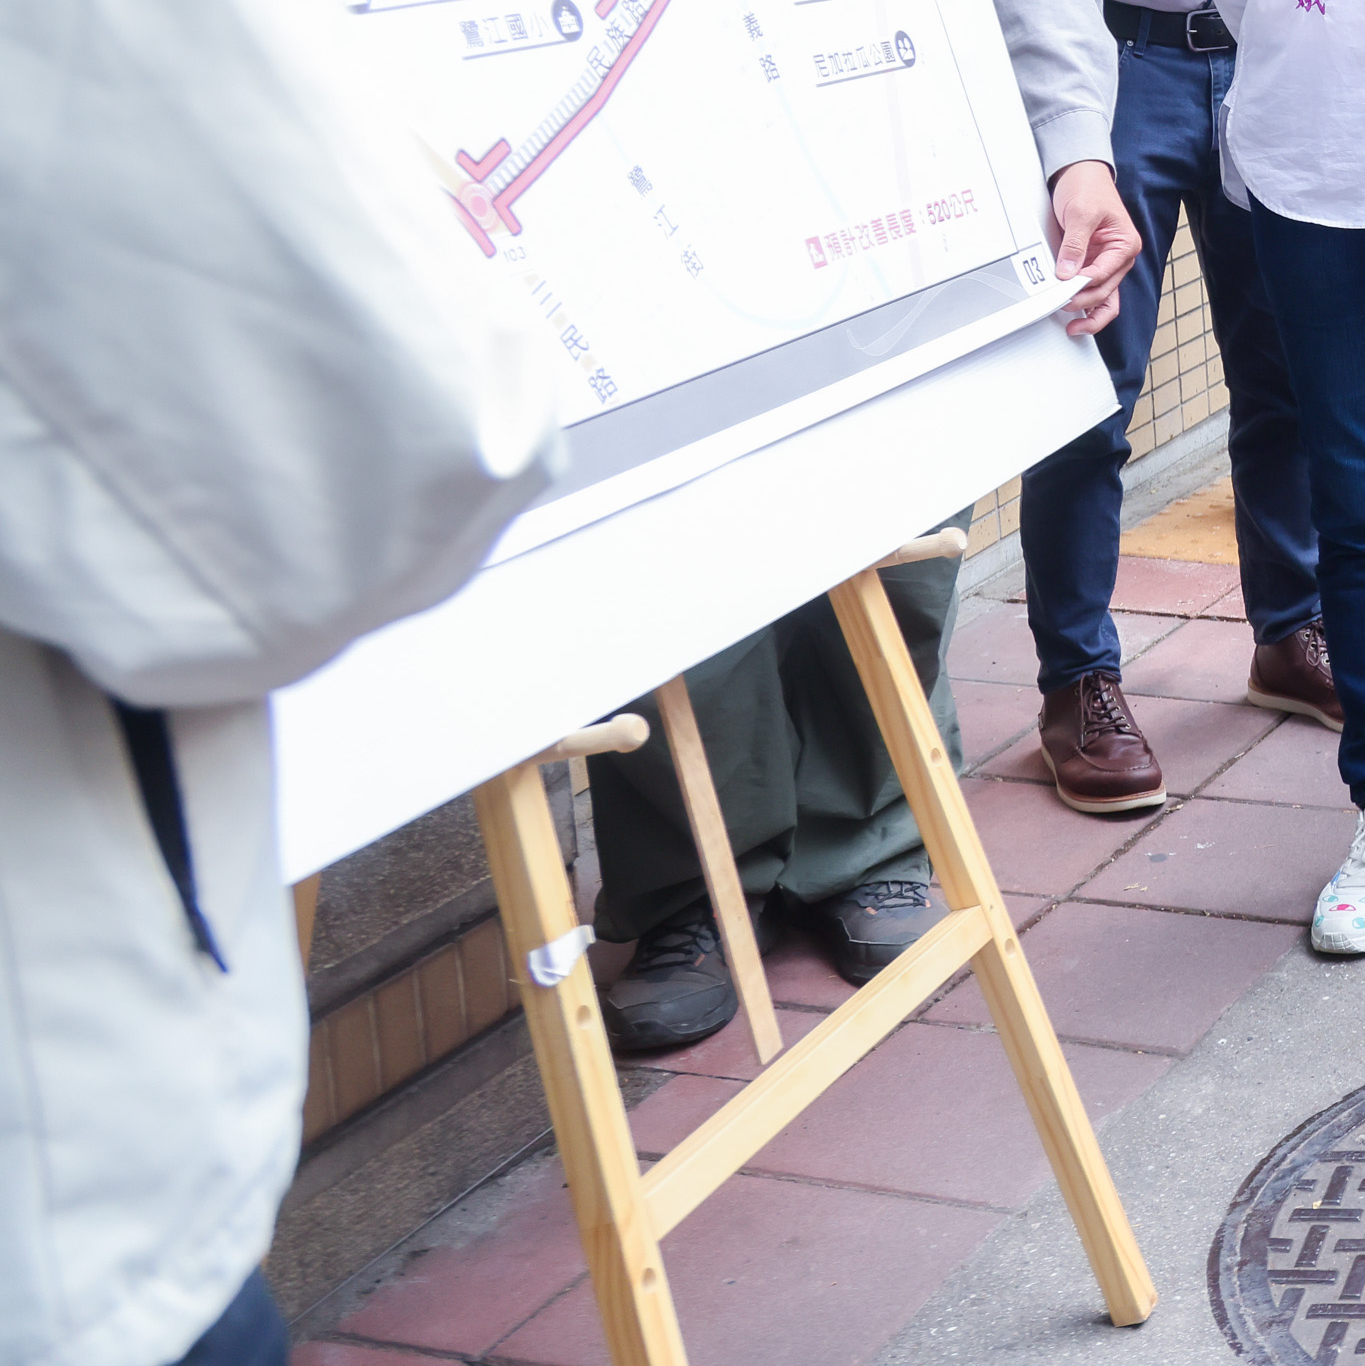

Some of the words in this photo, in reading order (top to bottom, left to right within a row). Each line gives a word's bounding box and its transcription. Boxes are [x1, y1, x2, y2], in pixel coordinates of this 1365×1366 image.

[812, 40, 897, 79] 尼加拉瓜公園
[1021, 256, 1046, 285] 03
